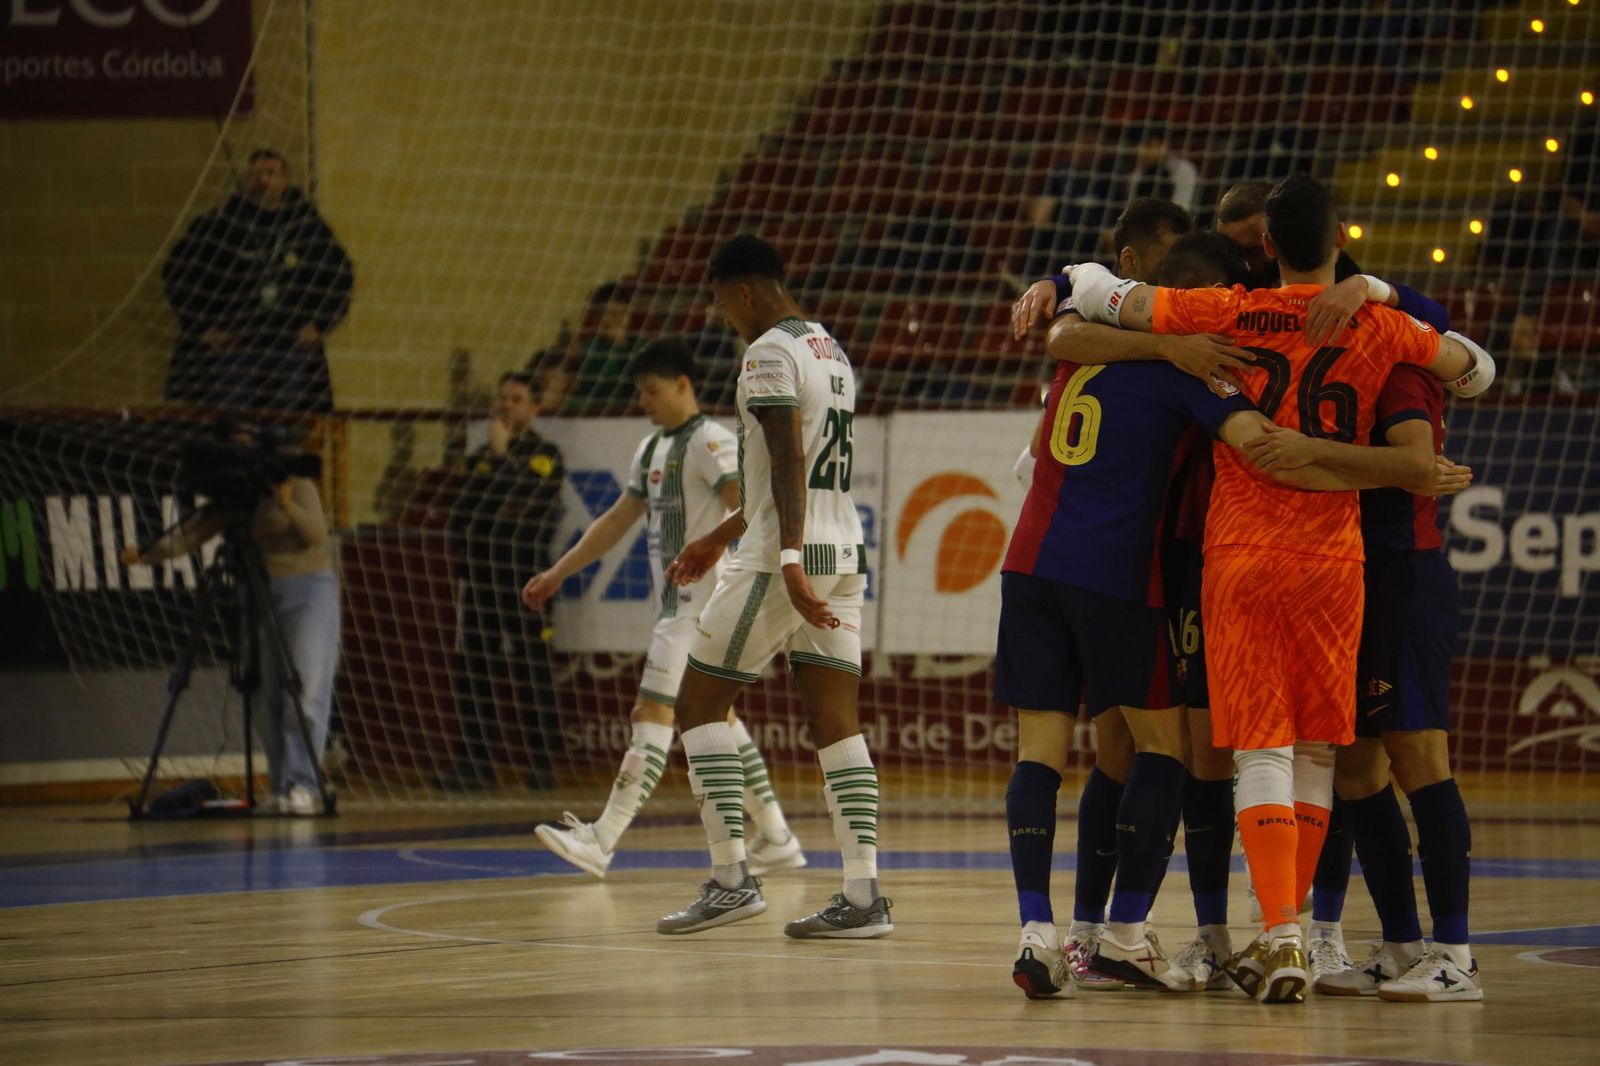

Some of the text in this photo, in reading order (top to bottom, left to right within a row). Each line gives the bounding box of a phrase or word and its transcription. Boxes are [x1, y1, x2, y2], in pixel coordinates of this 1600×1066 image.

[102, 49, 225, 80] Córdoba
[1236, 311, 1302, 337] MIQUEL
[1049, 364, 1107, 467] 6
[808, 407, 854, 493] 25
[1447, 484, 1600, 598] Sep
[900, 714, 951, 751] de
